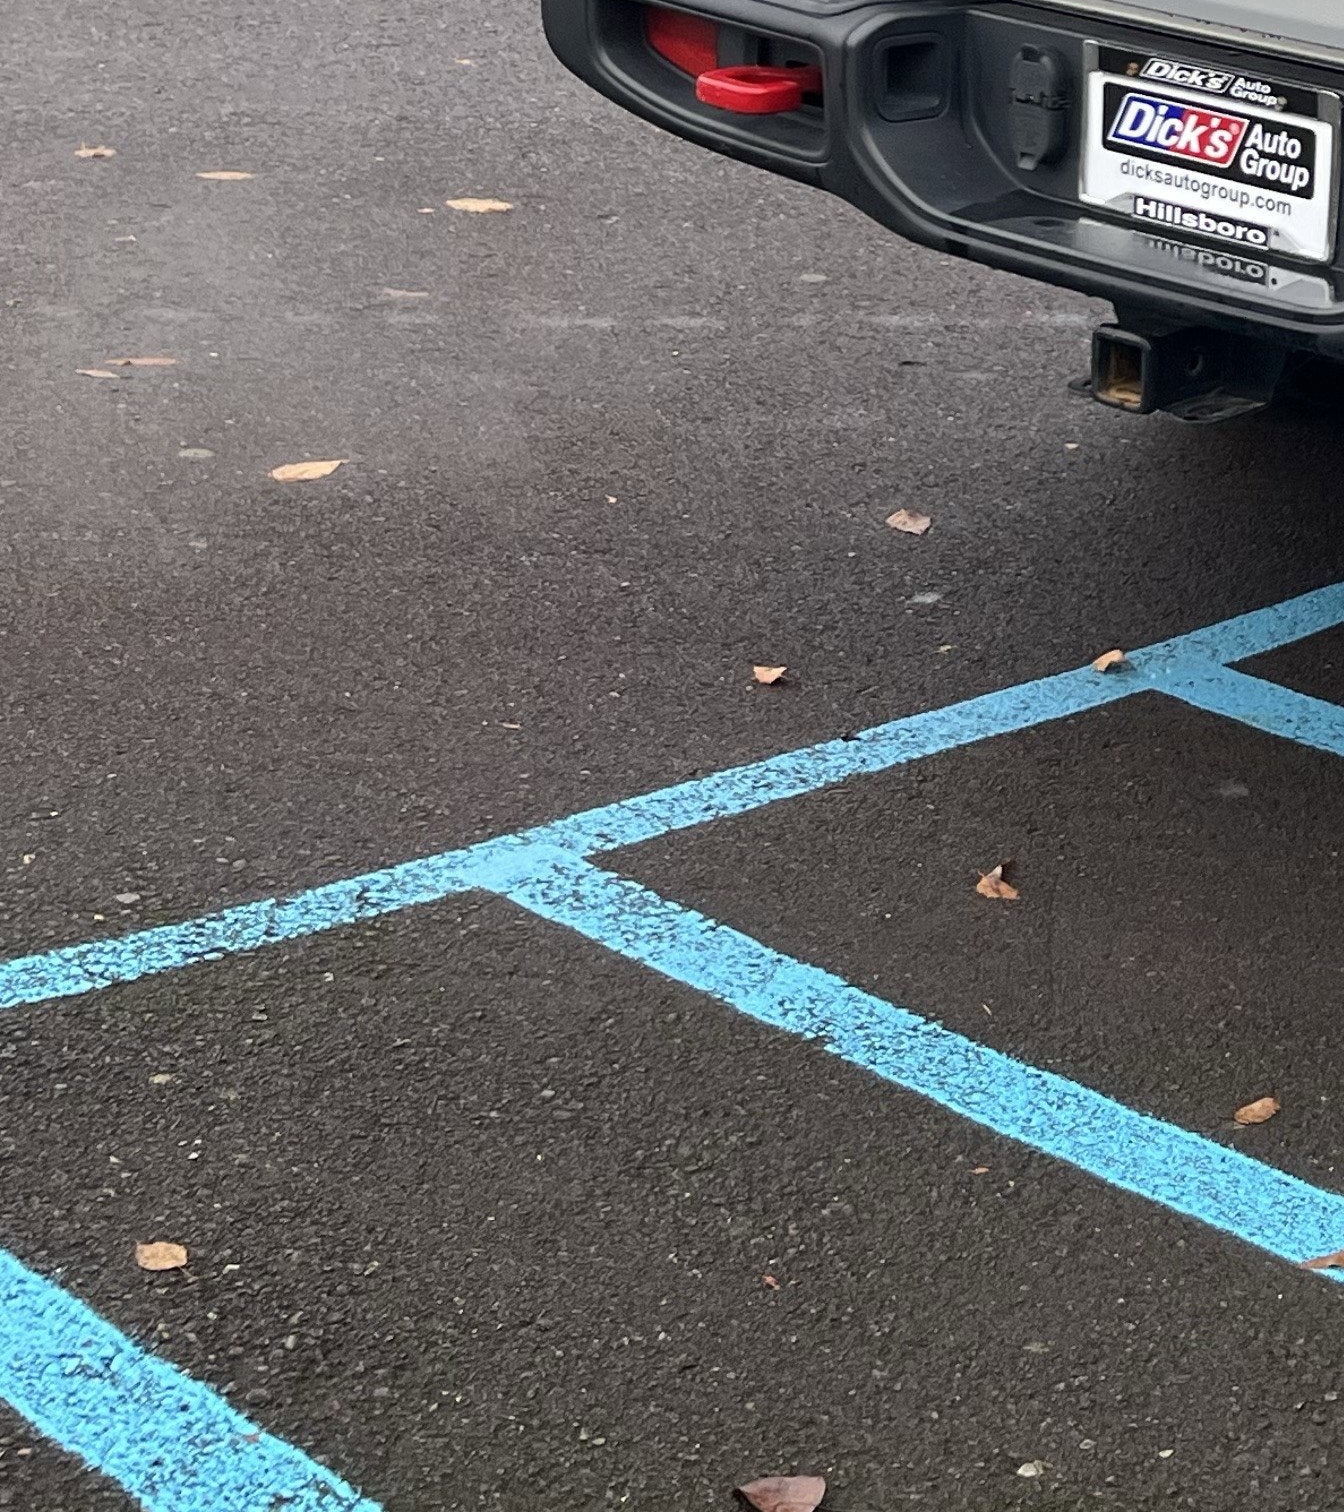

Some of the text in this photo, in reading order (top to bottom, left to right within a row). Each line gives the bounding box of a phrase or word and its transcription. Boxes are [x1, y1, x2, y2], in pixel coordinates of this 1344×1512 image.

[1145, 60, 1272, 95] Dick's Auto
[1229, 86, 1278, 107] Group
[1117, 100, 1302, 160] Dick's Auto
[1120, 159, 1292, 216] dicksautogroup.com
[1239, 149, 1310, 192] Group
[1135, 197, 1267, 245] Hillsboro
